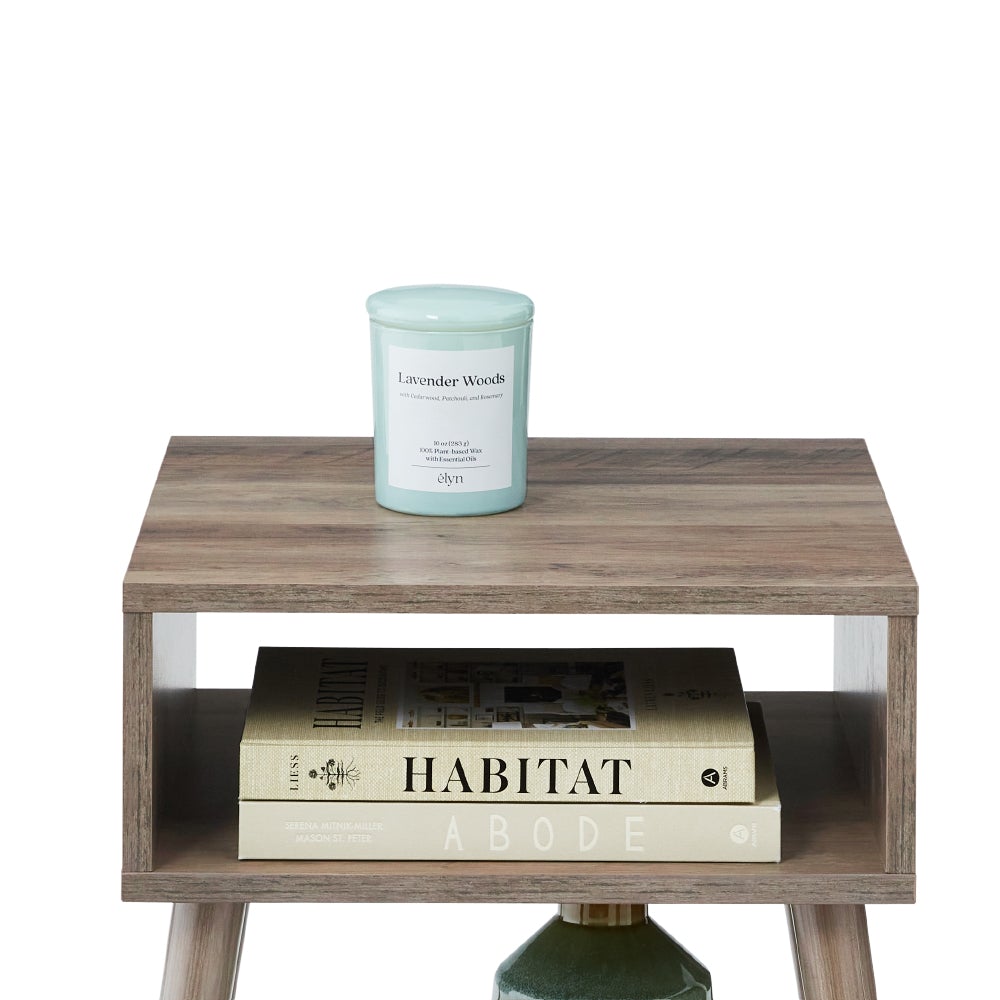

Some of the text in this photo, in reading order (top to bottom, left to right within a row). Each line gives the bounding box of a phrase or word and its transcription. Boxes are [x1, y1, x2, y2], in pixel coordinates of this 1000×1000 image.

[398, 372, 505, 387] Lavender Woods
[313, 658, 369, 729] HABITAT
[289, 754, 299, 791] LIESS
[402, 756, 632, 795] HABITAT
[444, 814, 645, 852] ABODE
